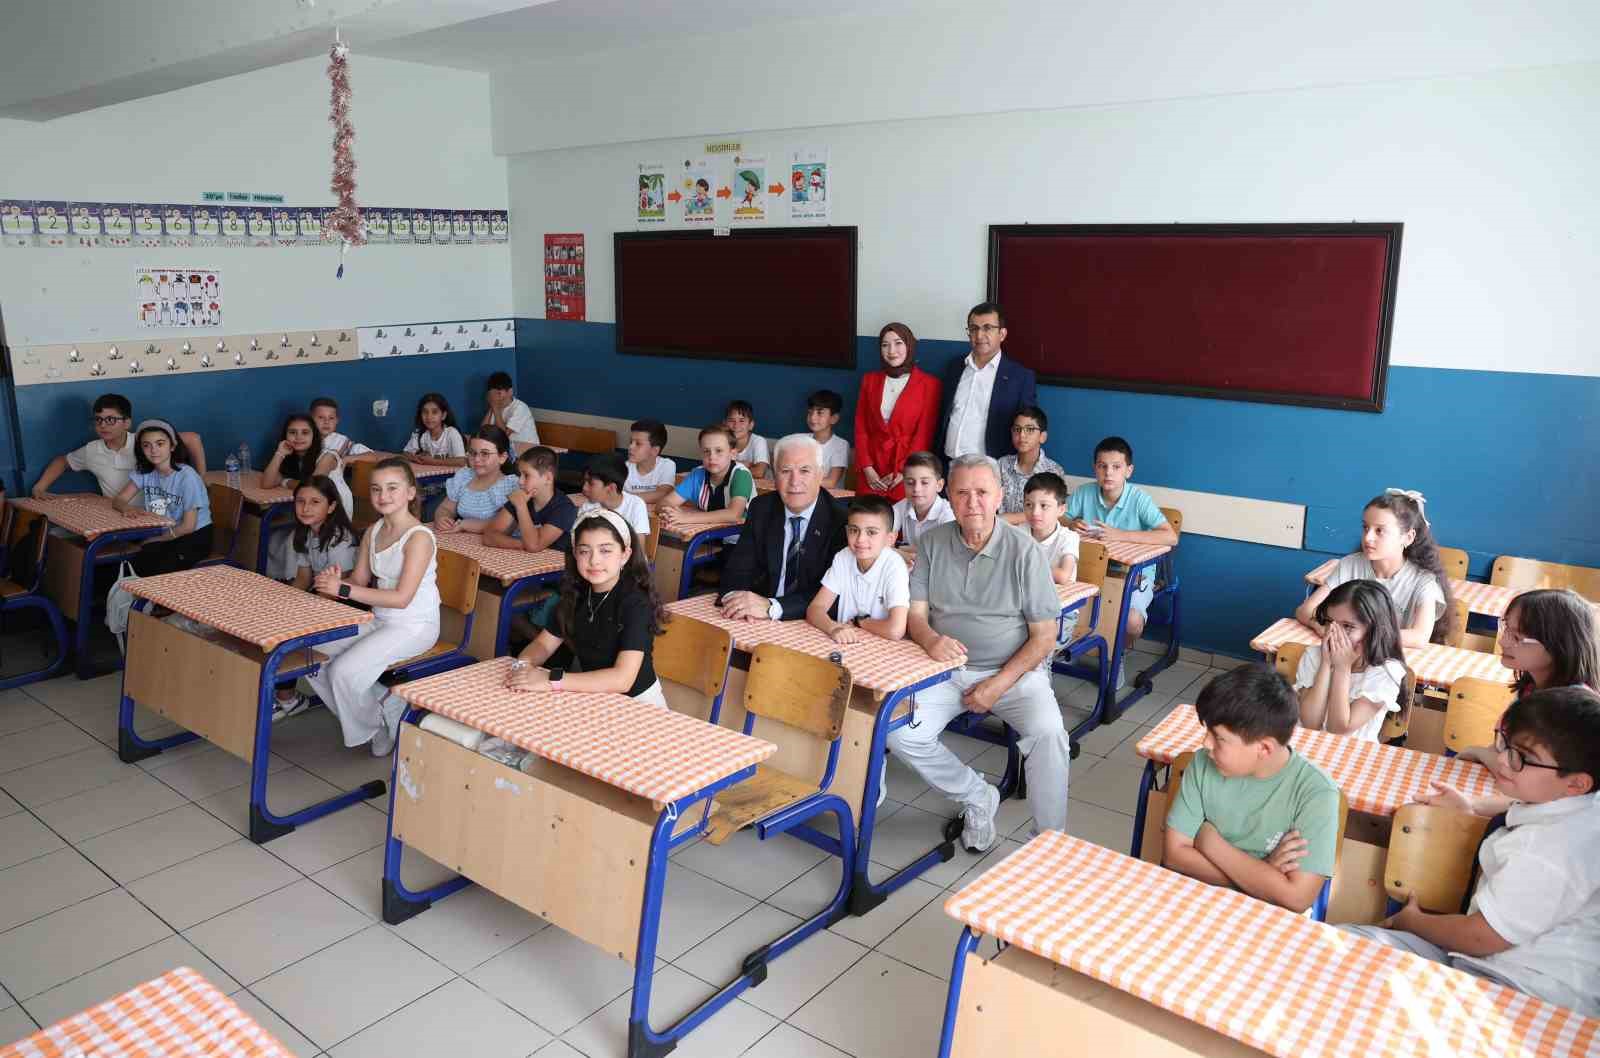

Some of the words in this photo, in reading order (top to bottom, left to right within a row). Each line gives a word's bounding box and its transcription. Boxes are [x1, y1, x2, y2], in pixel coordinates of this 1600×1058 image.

[48, 215, 58, 229] 2
[80, 216, 90, 230] 3
[144, 217, 153, 231] 5
[174, 218, 182, 231] 6
[230, 219, 238, 231] 8
[281, 220, 293, 232] 10
